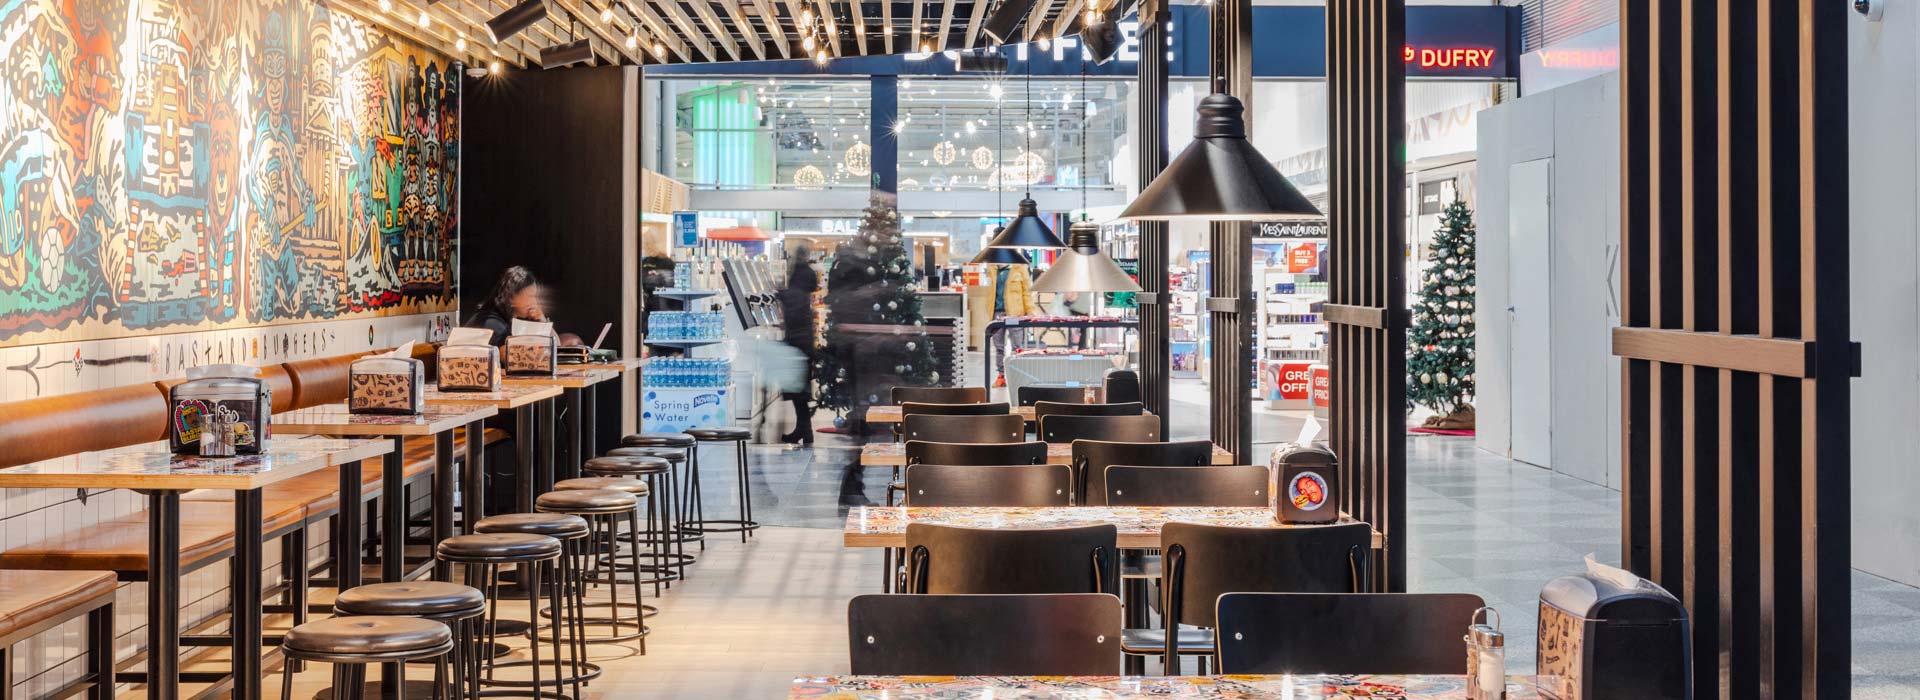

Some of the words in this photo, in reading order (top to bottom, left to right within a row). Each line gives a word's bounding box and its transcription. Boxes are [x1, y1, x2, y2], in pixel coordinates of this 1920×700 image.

[1420, 48, 1494, 67] DUFRY
[165, 336, 247, 375] BASTARD
[1285, 370, 1309, 381] GRE
[1315, 376, 1328, 387] GRE
[1314, 389, 1328, 400] PRIC
[654, 400, 690, 412] Spring
[655, 413, 689, 422] Water
